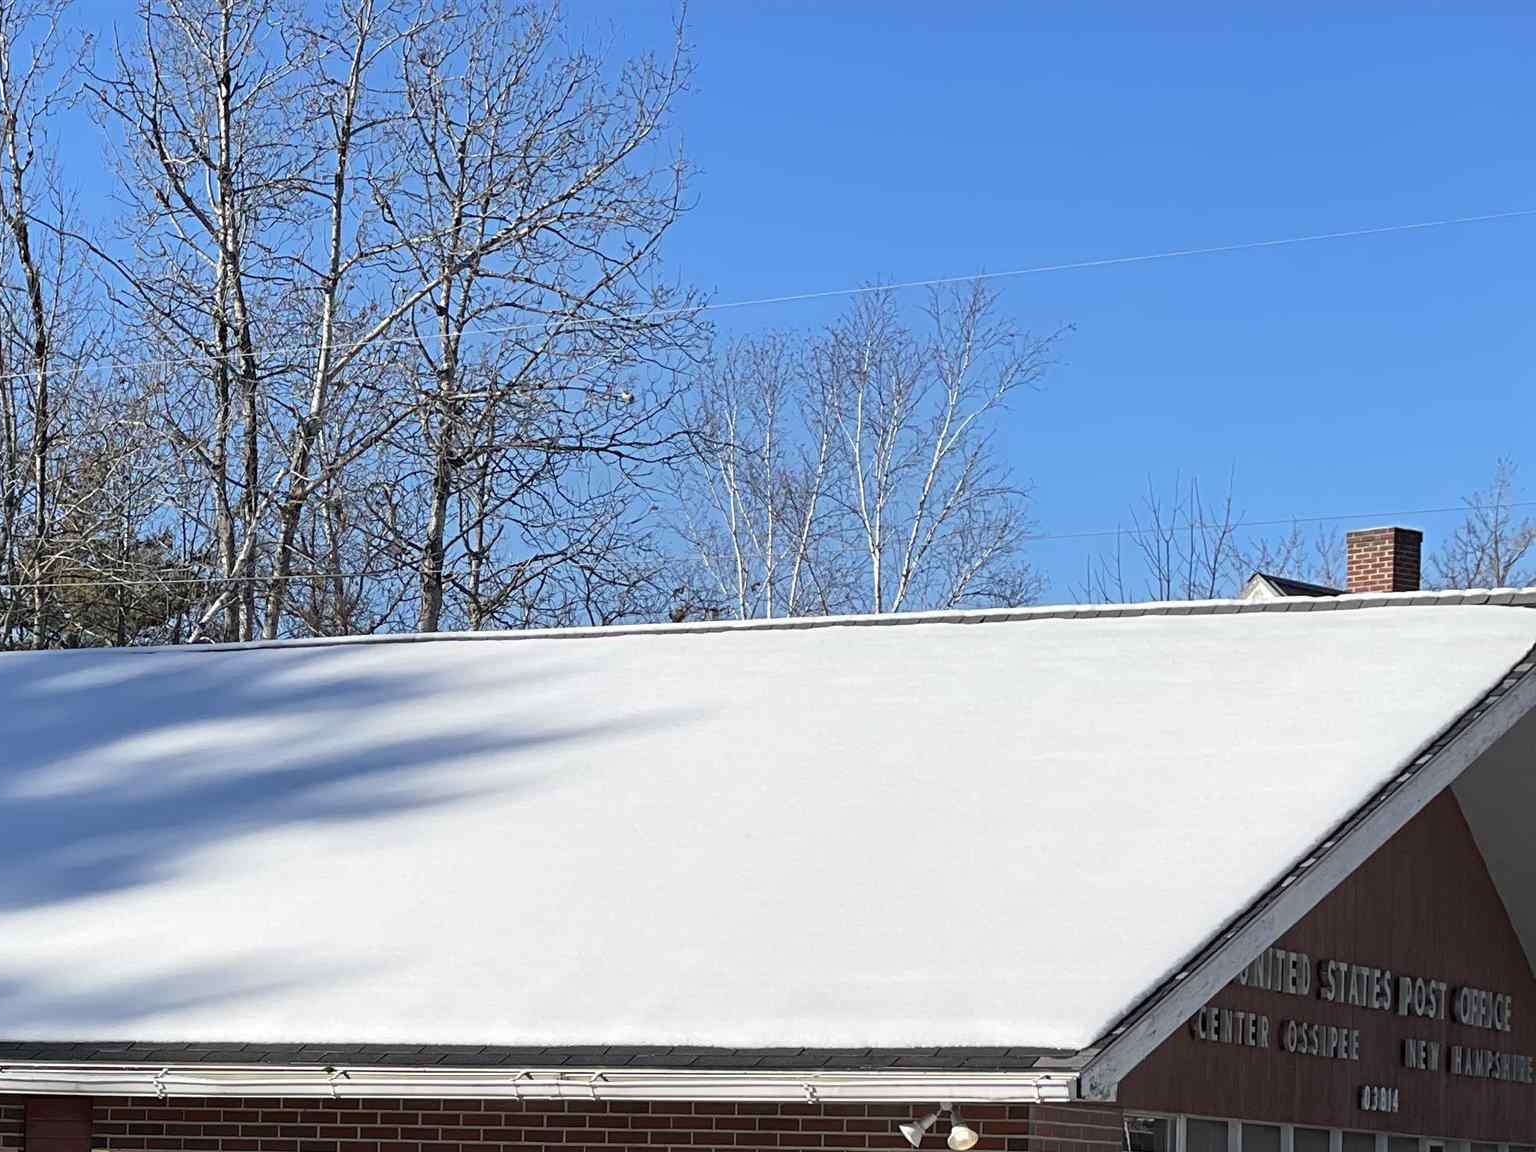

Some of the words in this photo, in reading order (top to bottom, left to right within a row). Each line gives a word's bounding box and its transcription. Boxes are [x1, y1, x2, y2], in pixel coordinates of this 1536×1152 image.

[1324, 959, 1392, 1011] STATES
[1399, 976, 1447, 1020] POST
[1458, 986, 1512, 1032] OFFICE
[1198, 1006, 1270, 1048] CENTER
[1286, 1019, 1360, 1061] OSSIPEE
[1405, 1038, 1440, 1072] NEW
